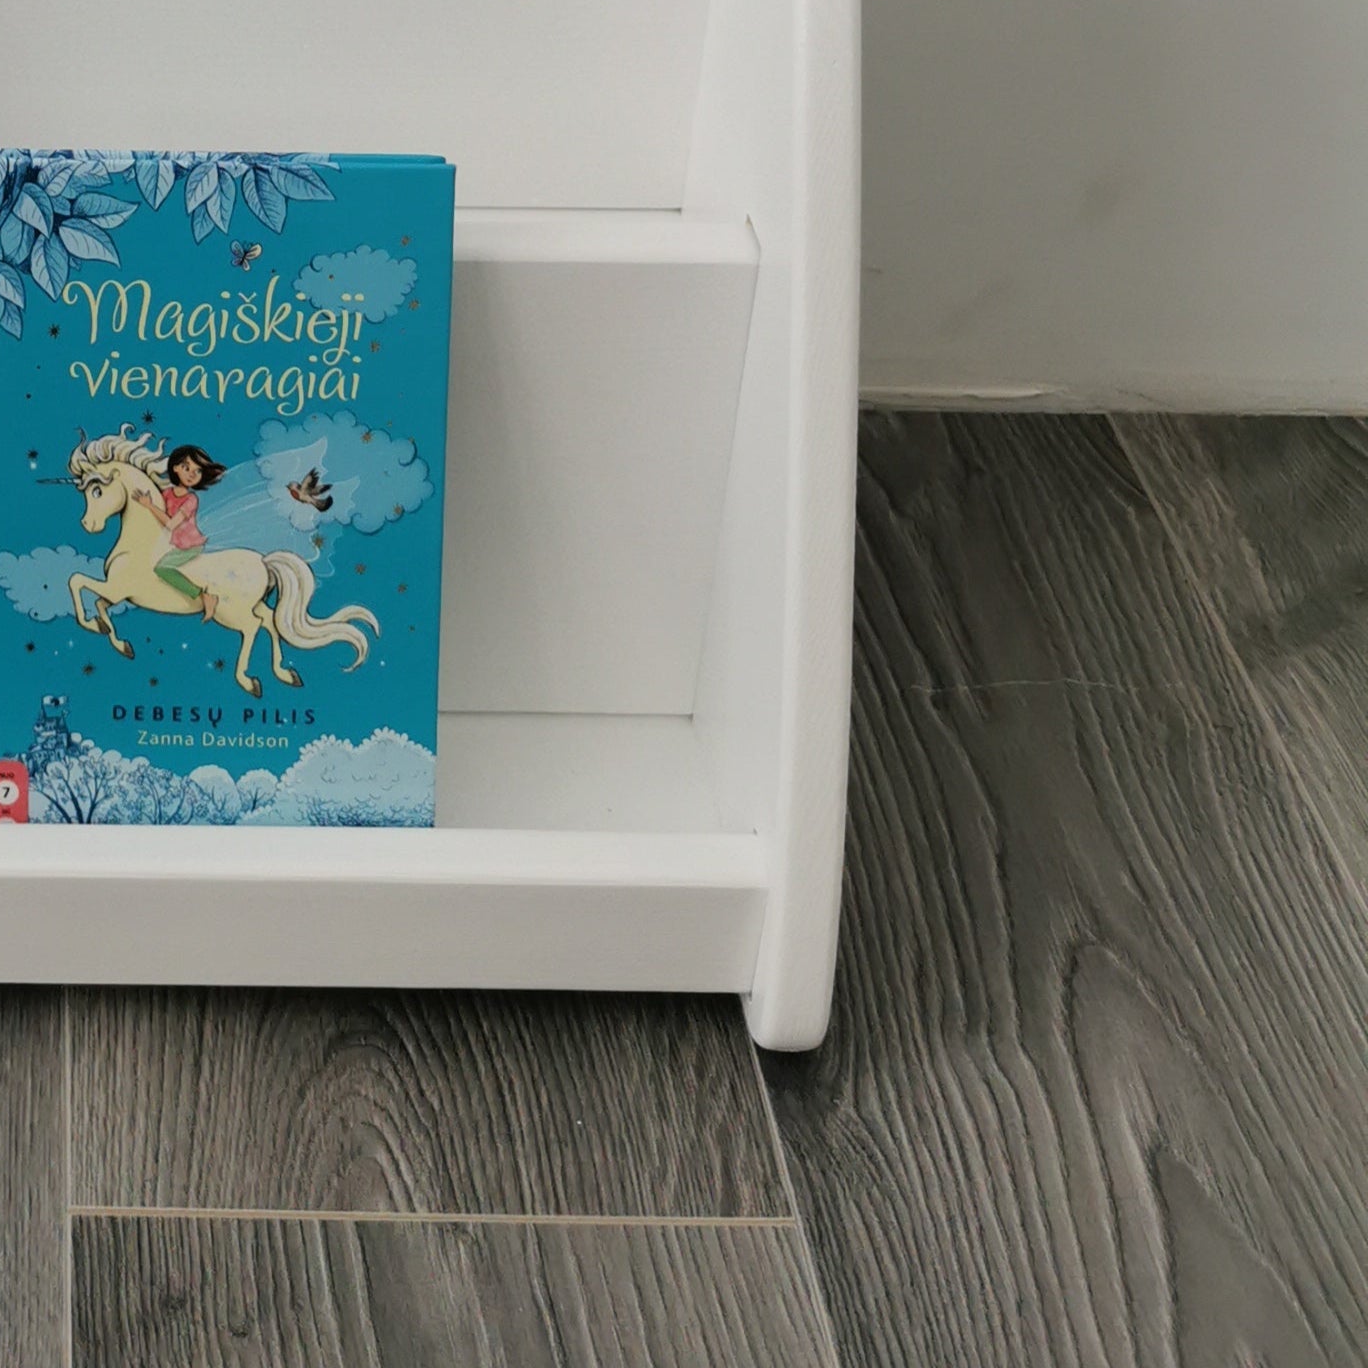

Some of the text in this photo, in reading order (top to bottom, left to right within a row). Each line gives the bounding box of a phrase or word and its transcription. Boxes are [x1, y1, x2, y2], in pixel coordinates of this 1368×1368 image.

[62, 275, 364, 365] Magiškieji
[69, 351, 362, 416] vienaragiai
[112, 705, 316, 728] DEBESŲ PILIS
[137, 730, 289, 748] Zanna Davidson
[2, 786, 10, 798] 7
